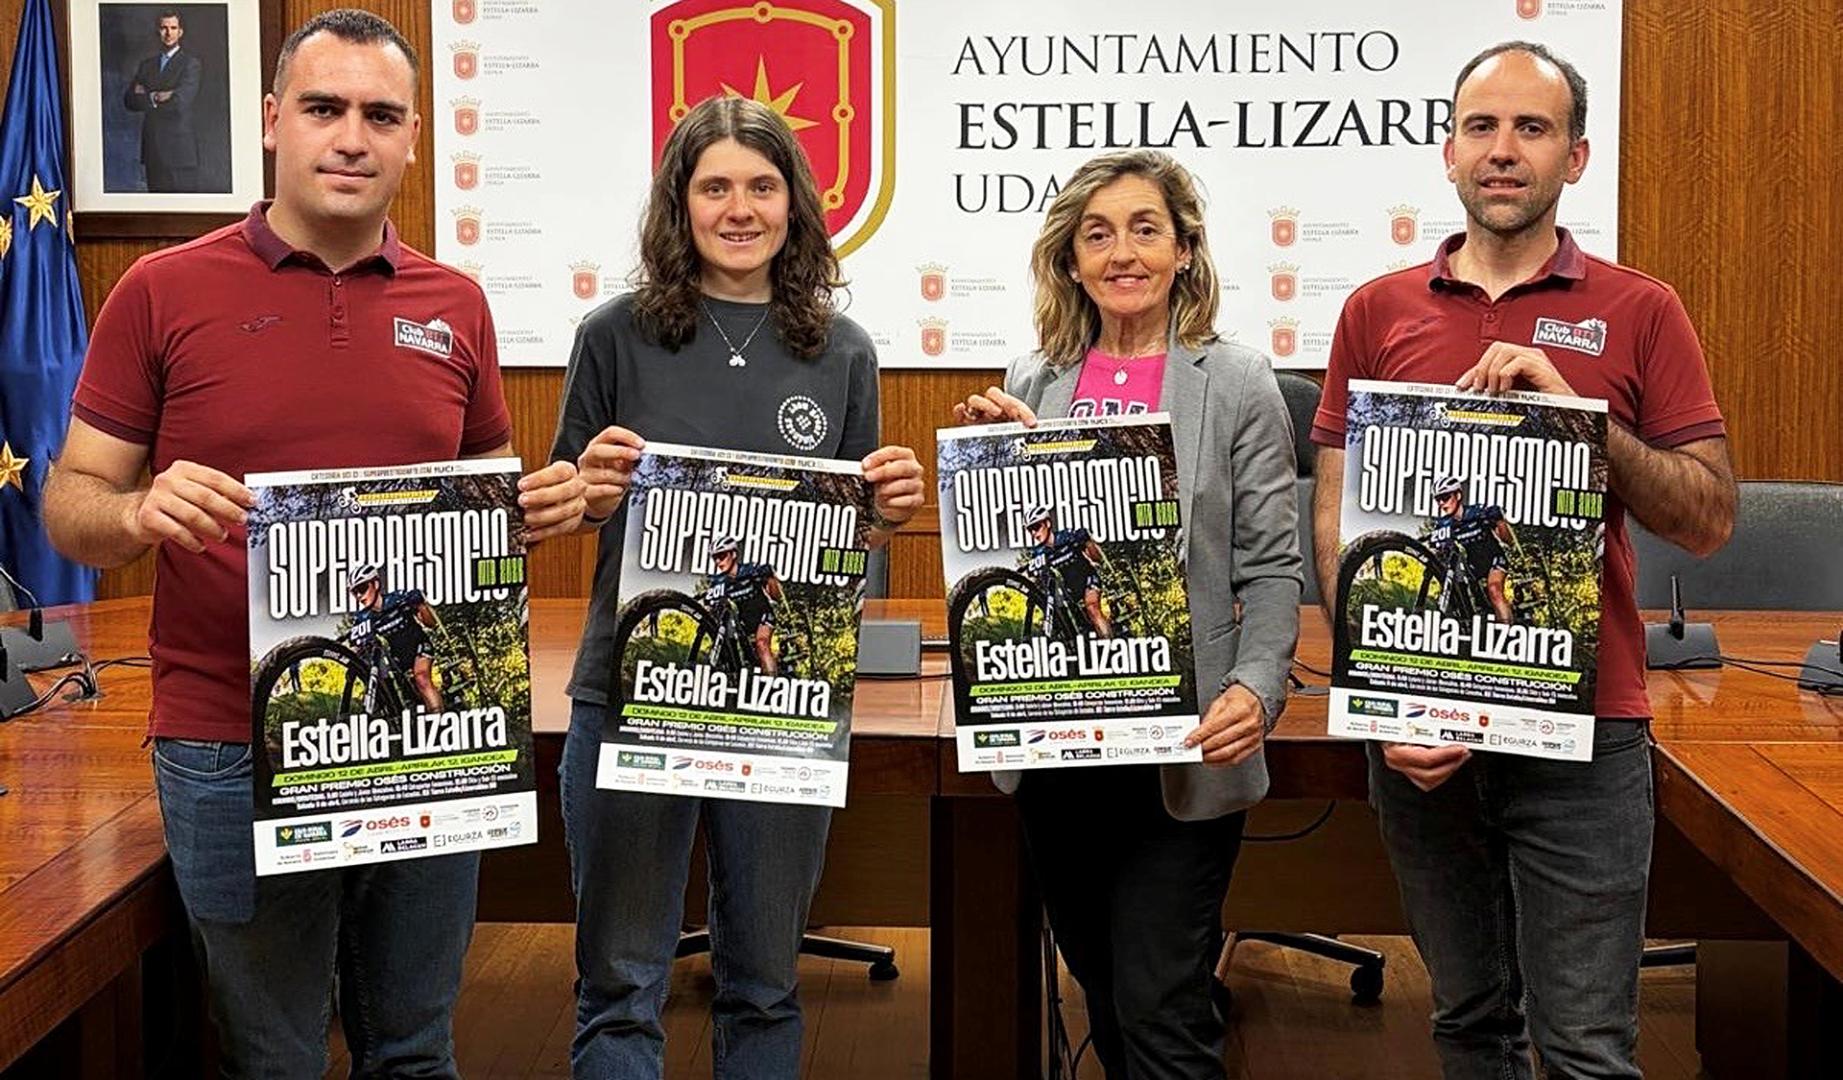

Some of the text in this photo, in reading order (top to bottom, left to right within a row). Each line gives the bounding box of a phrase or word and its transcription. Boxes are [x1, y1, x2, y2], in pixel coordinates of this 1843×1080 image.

[951, 31, 1399, 76] AYUNTAMIENTO
[955, 98, 1456, 150] ESTELLA-LIZARR
[953, 173, 1062, 214] UDA
[1544, 323, 1570, 335] Club
[399, 331, 448, 354] NAVARRA
[1538, 330, 1599, 351] NAVARRA
[1028, 554, 1046, 571] 201
[705, 583, 725, 601] 201
[350, 619, 371, 640] 201
[1361, 603, 1573, 668] Estella-Lizarra
[975, 631, 1171, 682] Estella-Lizarra
[1359, 652, 1407, 663] DOMINGO
[1420, 657, 1433, 666] DE
[1354, 661, 1390, 674] GRAN
[1392, 665, 1438, 678] PREMIO
[1474, 671, 1572, 691] CONSTRUCCIÓN
[633, 659, 830, 718] Estella-Lizarra
[975, 695, 1008, 704] GRAN
[1009, 692, 1052, 702] PREMIO
[1084, 685, 1174, 699] CONSTRUCCIÓN
[1428, 706, 1470, 722] osés
[282, 704, 507, 769] Estella-Lizarra
[625, 716, 659, 727] GRAN
[661, 719, 706, 731] PREMIO
[738, 724, 828, 741] CONSTRUCCIÓN
[1047, 728, 1086, 740] osés
[283, 770, 335, 783] DOMINGO
[349, 767, 363, 776] DE
[694, 757, 734, 772] osés
[279, 783, 318, 796] GRAN
[320, 777, 370, 792] PREMIO
[409, 760, 511, 782] CONSTRUCCIÓN
[365, 814, 410, 831] osés
